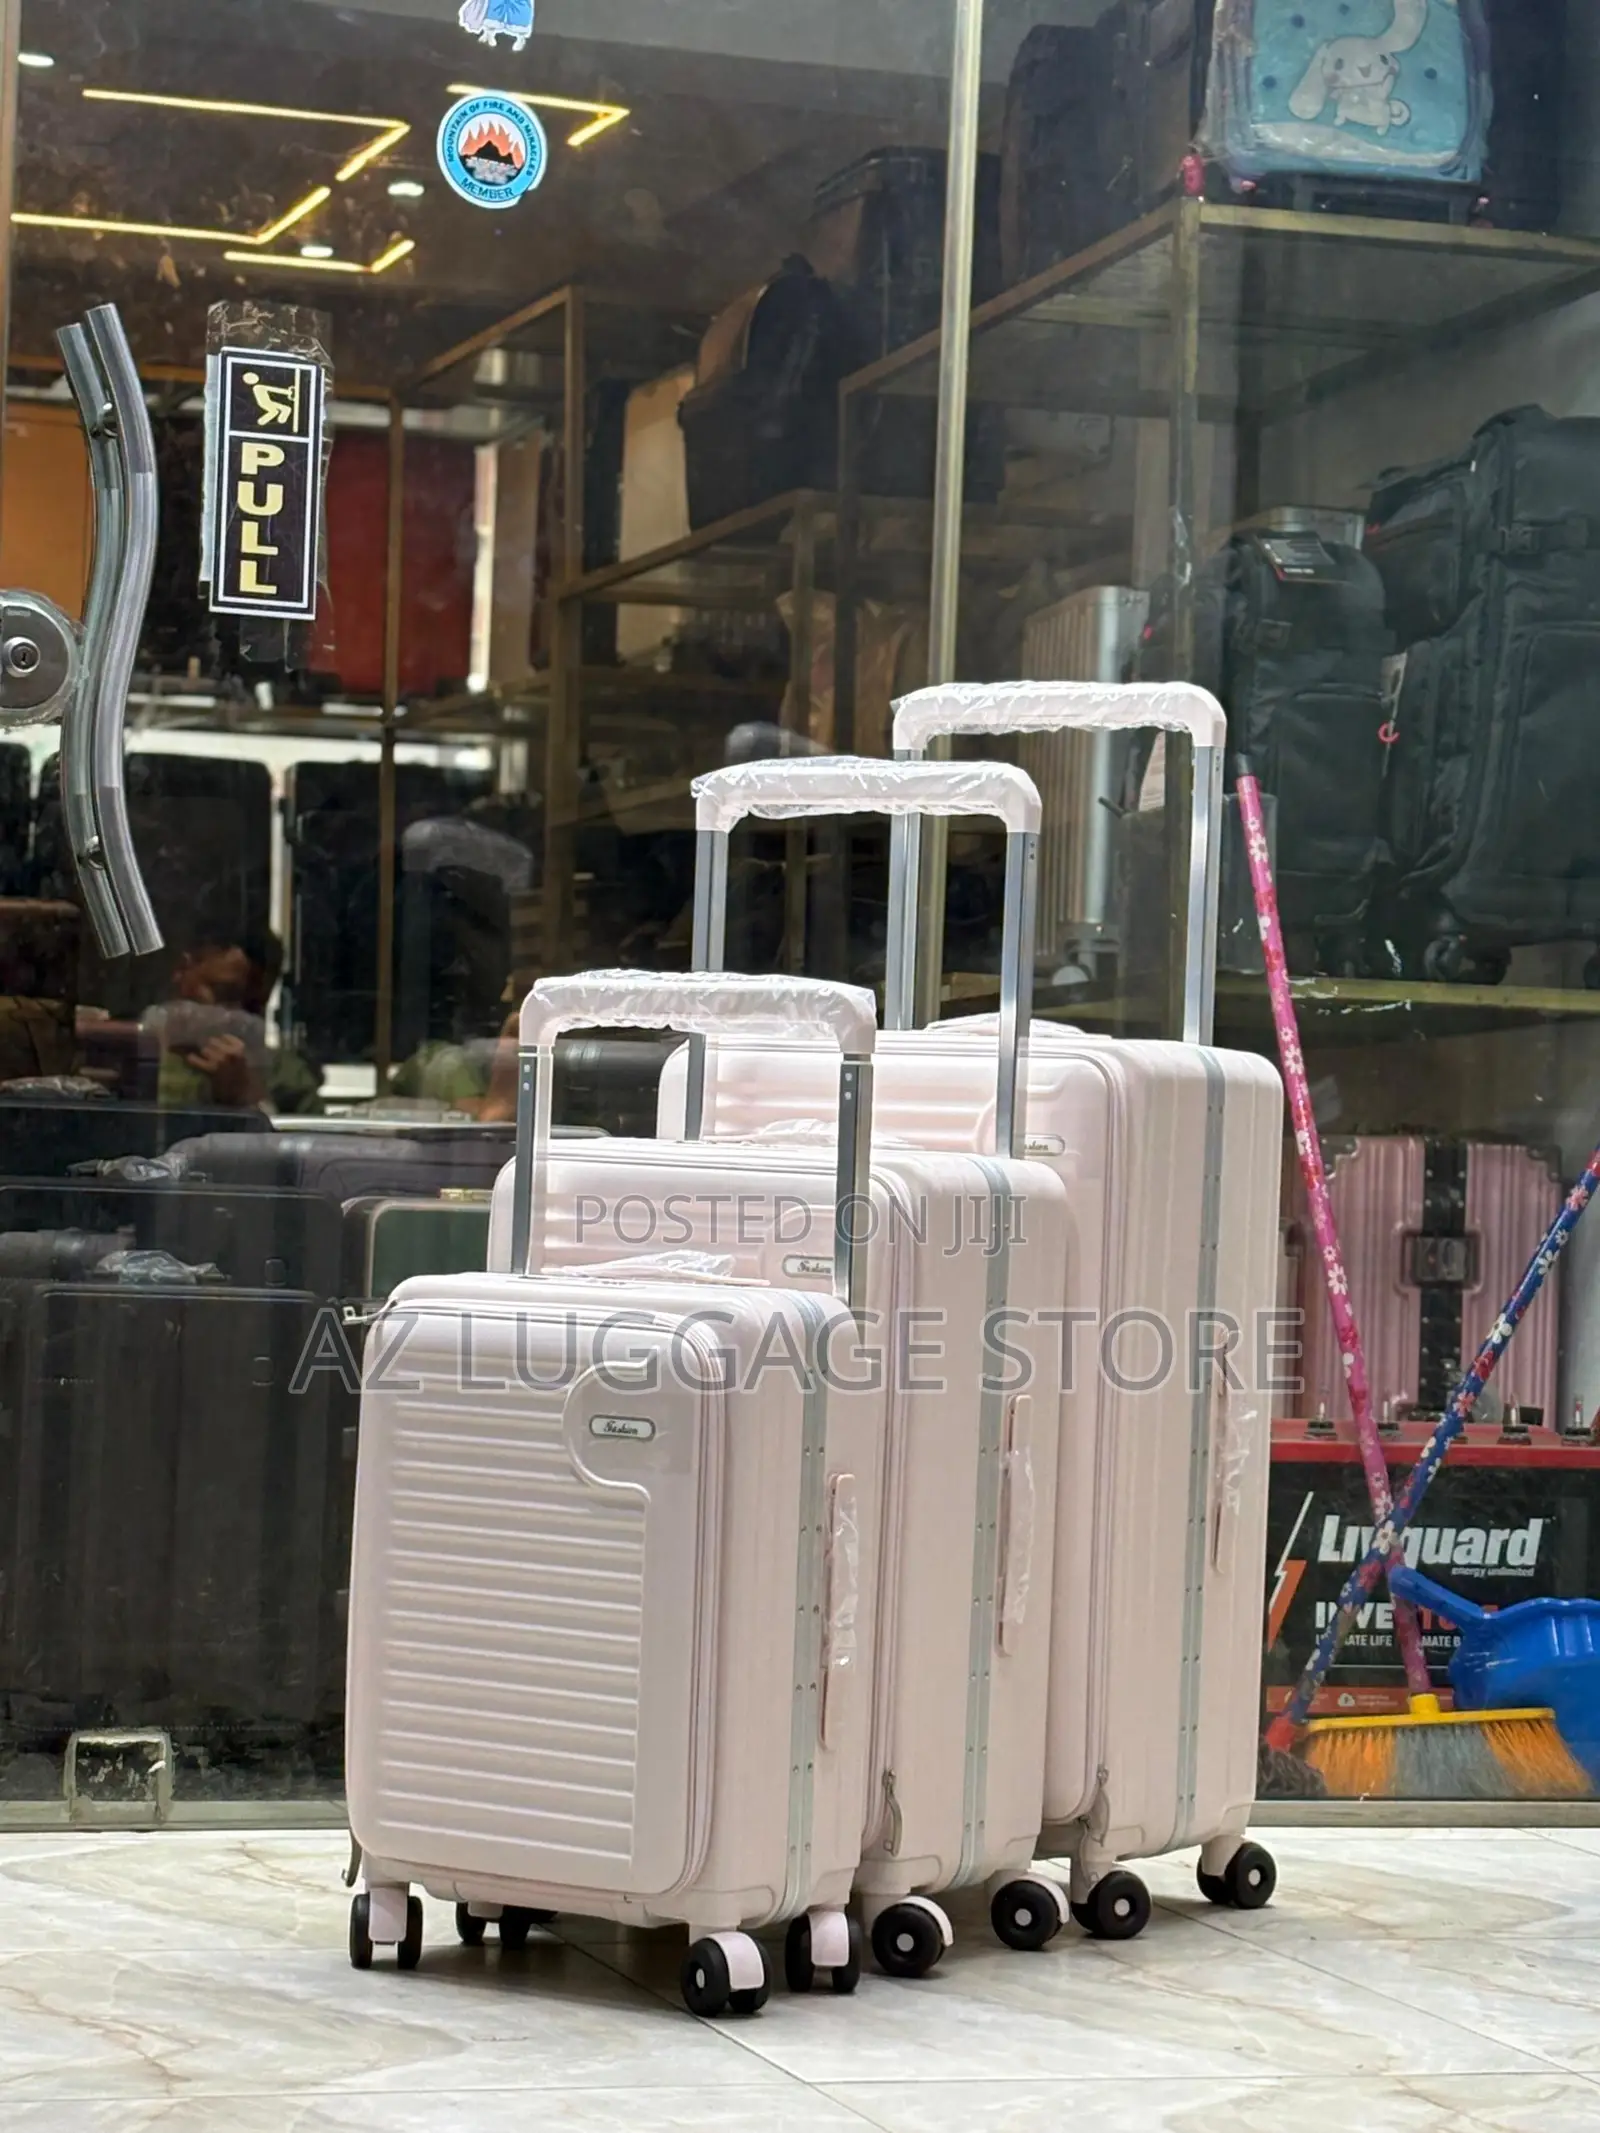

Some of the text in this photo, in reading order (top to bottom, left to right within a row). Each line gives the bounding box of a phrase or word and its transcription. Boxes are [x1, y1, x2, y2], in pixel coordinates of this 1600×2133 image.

[446, 111, 469, 162] MOUNTAIN
[469, 101, 480, 113] OF
[483, 100, 505, 111] FIRE
[506, 107, 525, 125] AND
[461, 178, 514, 199] MEMBER
[237, 442, 285, 594] PULL
[1369, 1635, 1393, 1647] LIFE
